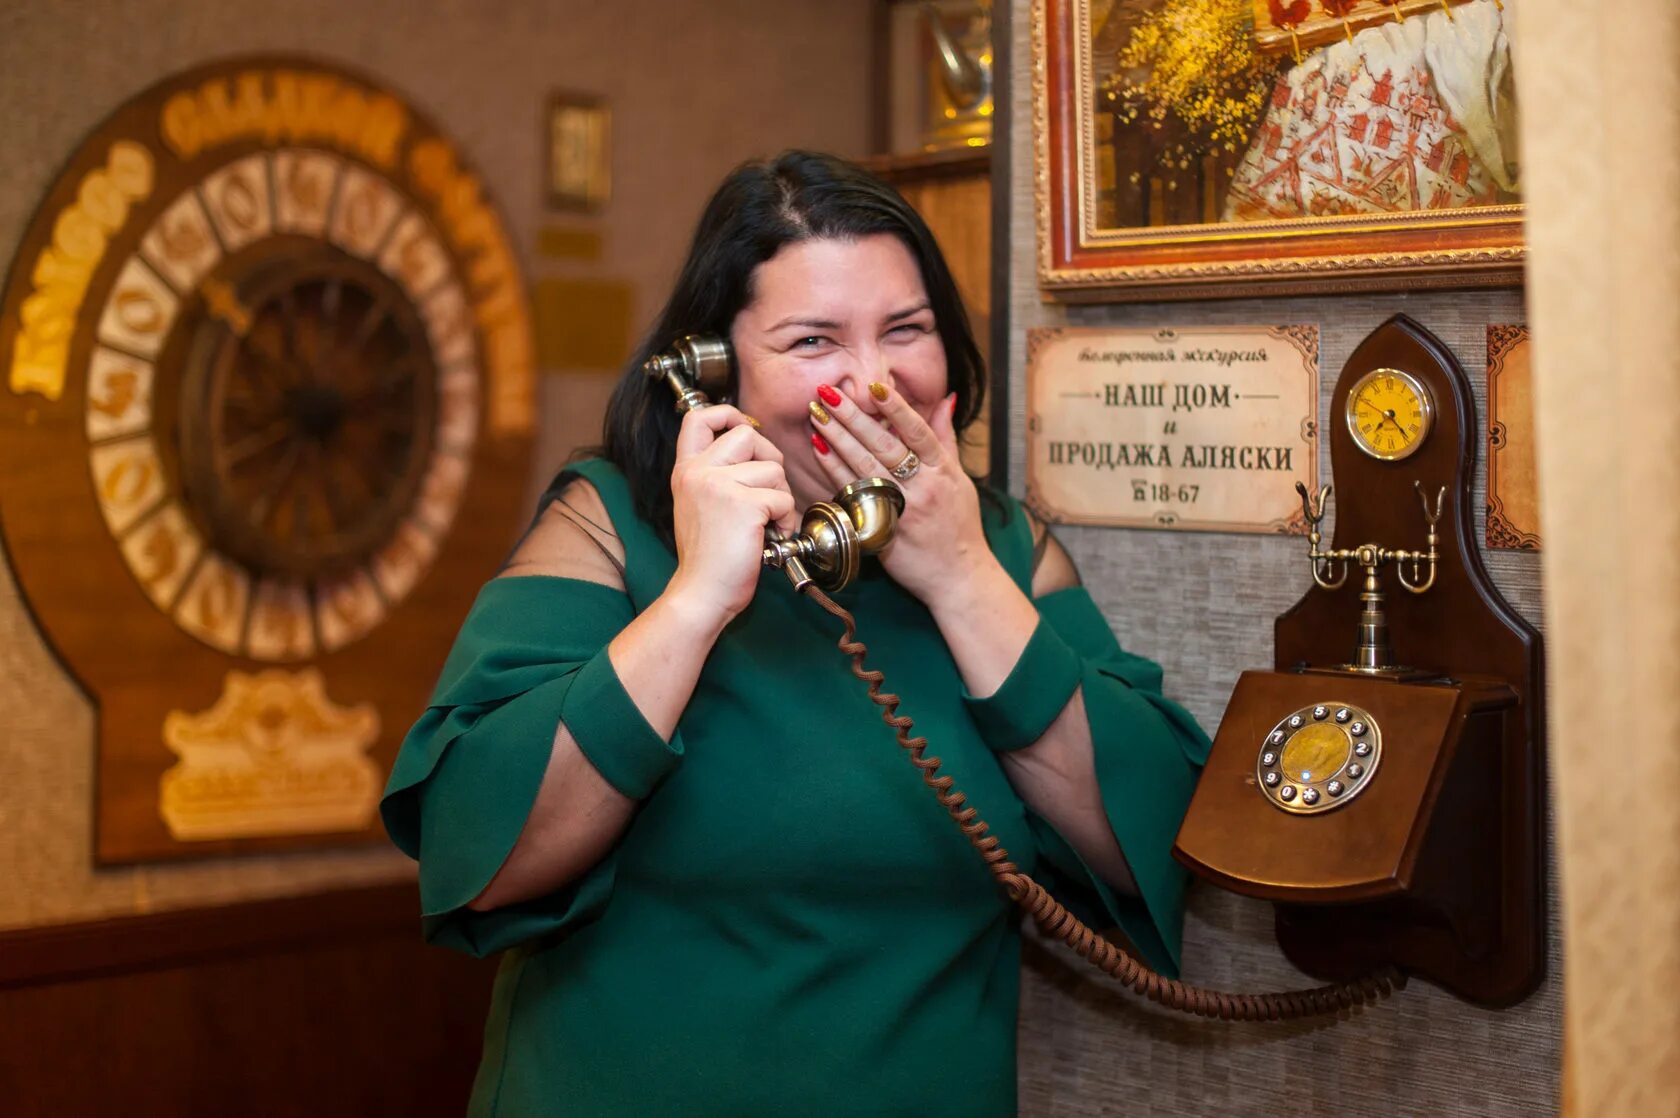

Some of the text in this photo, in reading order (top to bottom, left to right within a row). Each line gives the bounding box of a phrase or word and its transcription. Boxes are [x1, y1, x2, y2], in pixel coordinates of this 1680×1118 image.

[1104, 383, 1232, 412] НАШ ДОМ
[1163, 420, 1178, 435] и
[1048, 440, 1294, 472] ПРОДАЖА АЛЯСКИ
[1152, 484, 1200, 504] 18-67
[1314, 706, 1325, 716] 5
[1336, 709, 1347, 719] 4
[1291, 715, 1301, 726] 6
[1351, 723, 1361, 733] 3
[1273, 730, 1284, 741] 7
[1355, 743, 1366, 753] 2
[1263, 752, 1274, 763] 8
[1266, 772, 1277, 783] 9
[1281, 786, 1292, 797] 0
